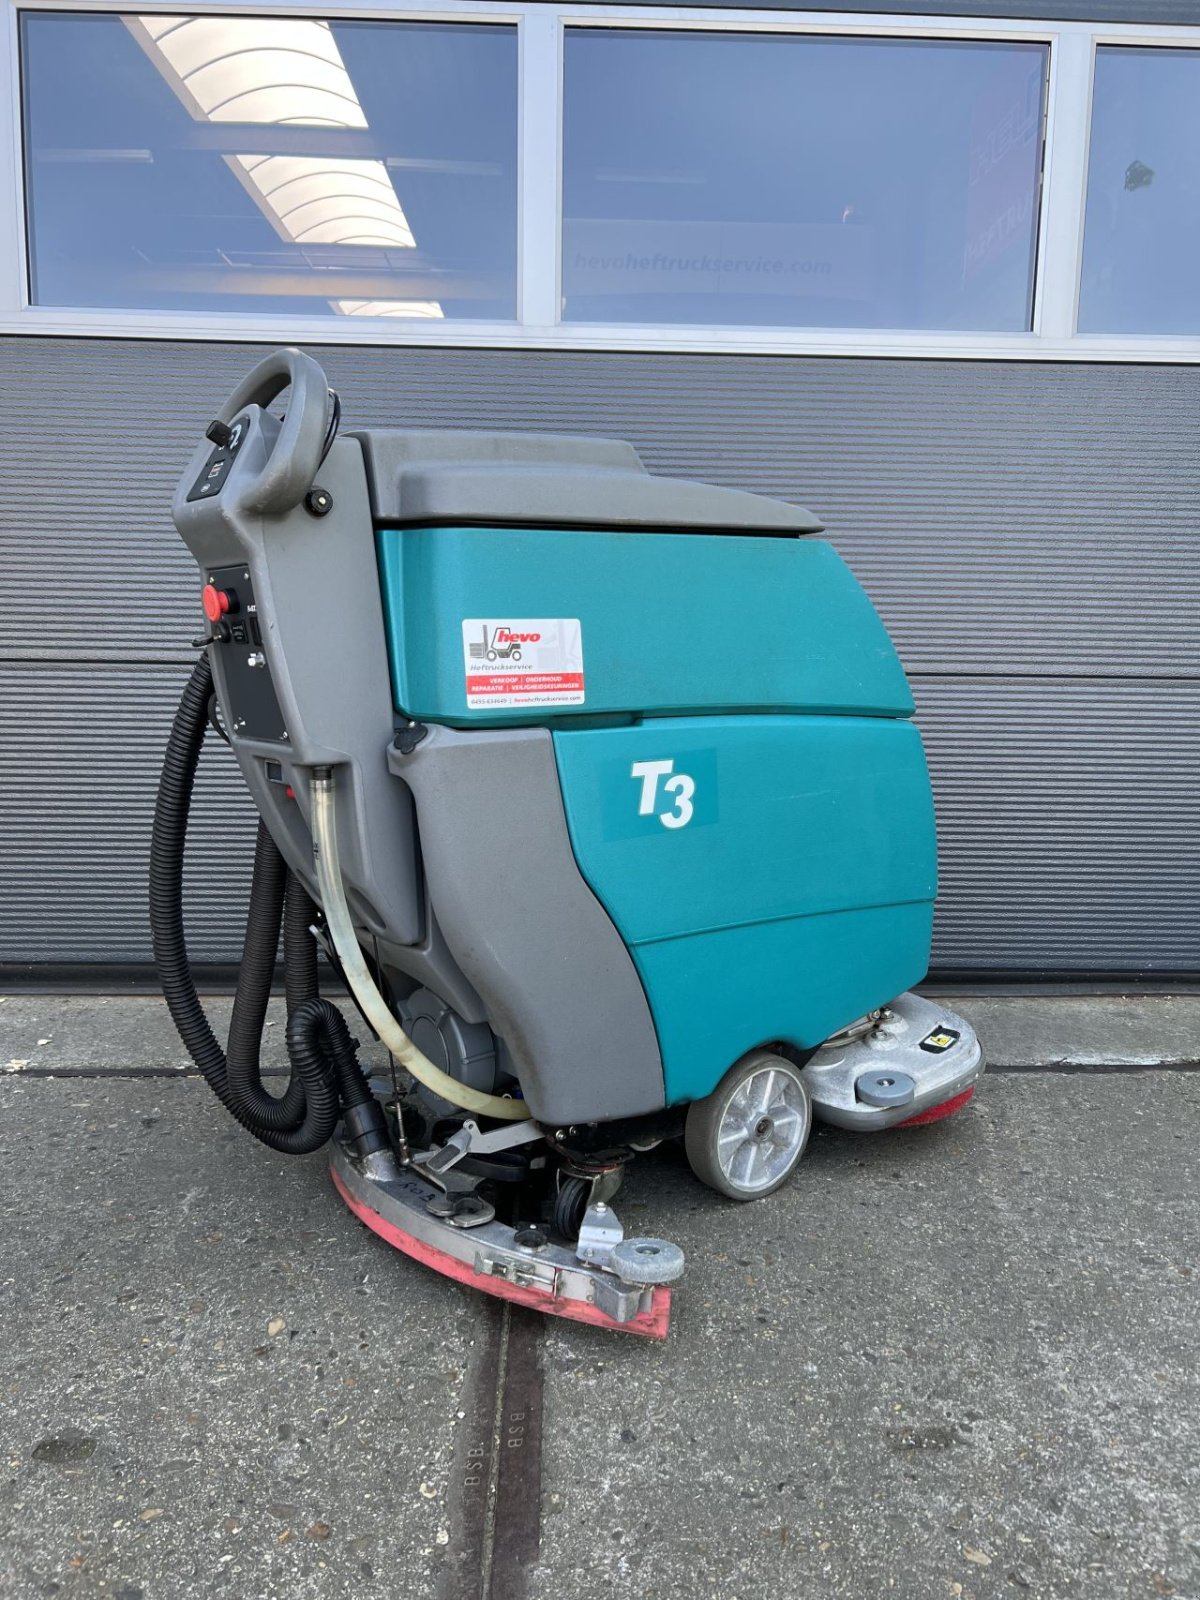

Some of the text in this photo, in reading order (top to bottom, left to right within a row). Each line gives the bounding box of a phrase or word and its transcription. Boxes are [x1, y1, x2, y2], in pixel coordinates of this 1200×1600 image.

[574, 252, 832, 275] hevoheftruckservice.com
[497, 630, 541, 643] hevo
[631, 760, 695, 829] T3
[507, 1412, 525, 1448] BSB
[464, 1448, 484, 1486] BSB
